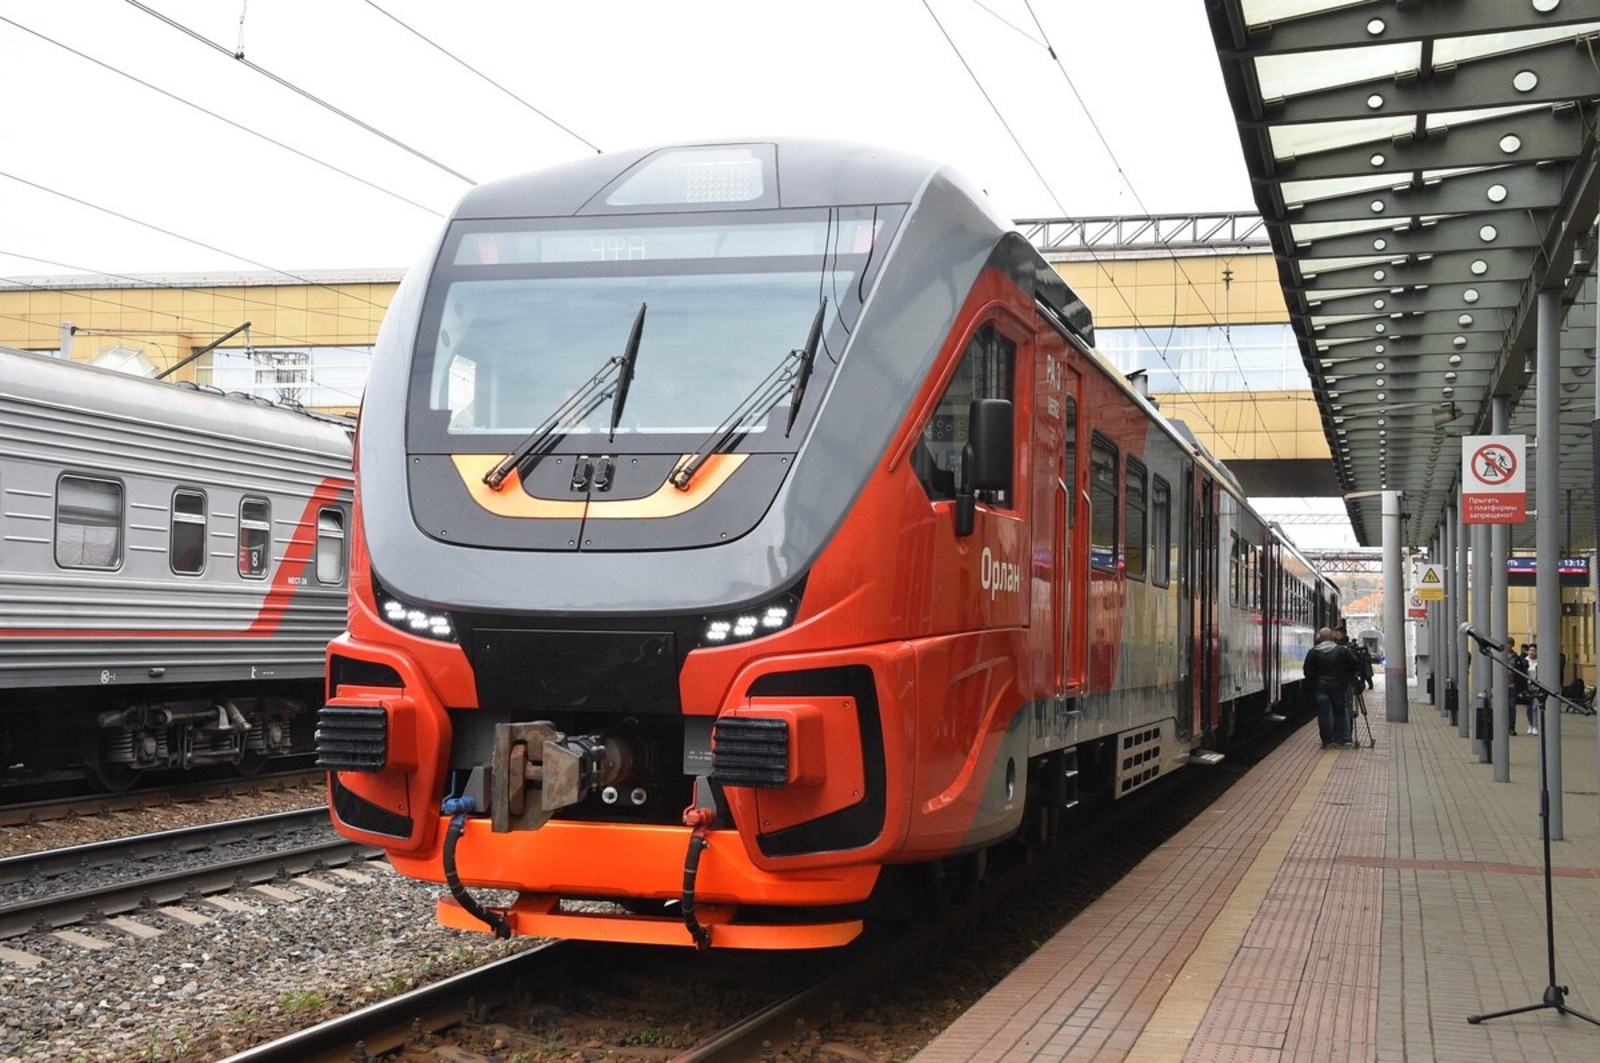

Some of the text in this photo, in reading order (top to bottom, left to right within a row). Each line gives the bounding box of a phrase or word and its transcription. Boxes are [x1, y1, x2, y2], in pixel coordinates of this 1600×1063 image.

[1468, 496, 1500, 504] Прыгать
[251, 551, 258, 567] 8
[981, 546, 1020, 601] Орлан
